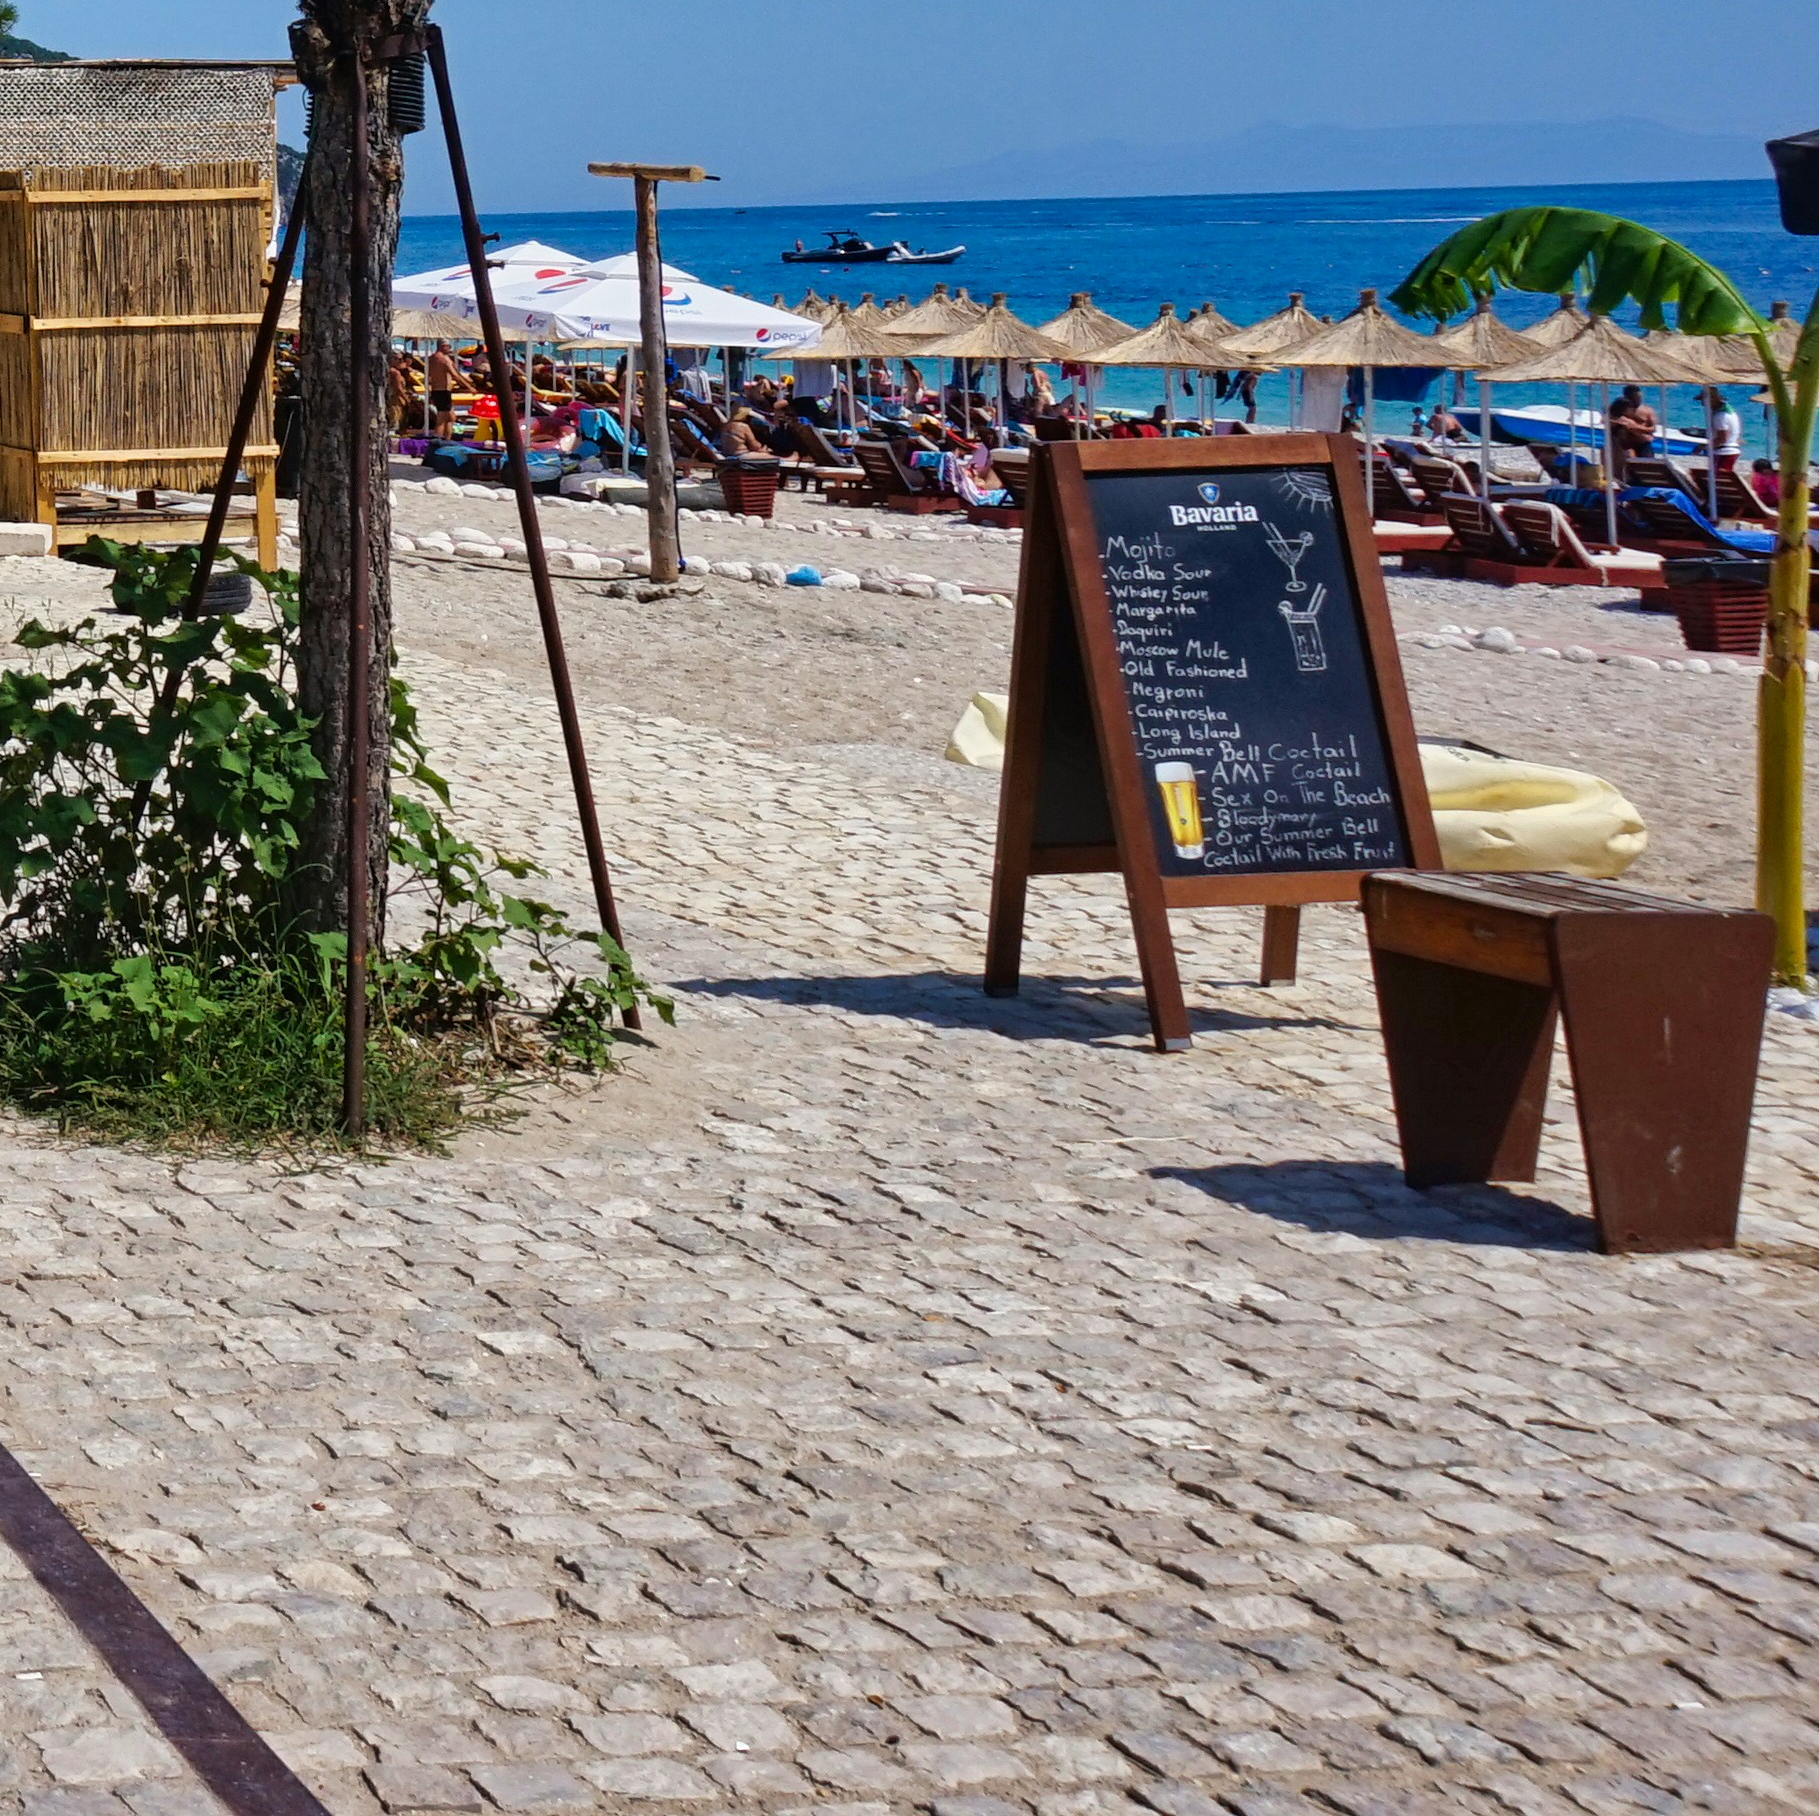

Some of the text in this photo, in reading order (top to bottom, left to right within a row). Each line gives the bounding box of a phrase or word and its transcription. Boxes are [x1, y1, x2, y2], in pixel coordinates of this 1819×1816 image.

[773, 332, 808, 342] pepsi
[1168, 501, 1260, 526] Bavaria
[1196, 524, 1237, 532] HOLLAND
[1106, 531, 1176, 564] Mojito
[1109, 562, 1213, 581] Vodka Sour
[1172, 585, 1210, 602] Sour
[1116, 602, 1197, 621] Margarita
[1120, 638, 1230, 660] Moscow Mule
[1124, 657, 1248, 679] Old Fashioned
[1132, 681, 1204, 703] Negroni
[1134, 703, 1229, 722] Caipiroska
[1139, 721, 1241, 744] Long Island
[1143, 732, 1359, 763] Summer Bell Coctail
[1211, 761, 1361, 785] AMF Coctail
[1211, 781, 1392, 807] Sex On The Beach
[1216, 816, 1380, 846] Our Summer Bell
[1203, 840, 1396, 868] Coctail With Fresh Fruit
